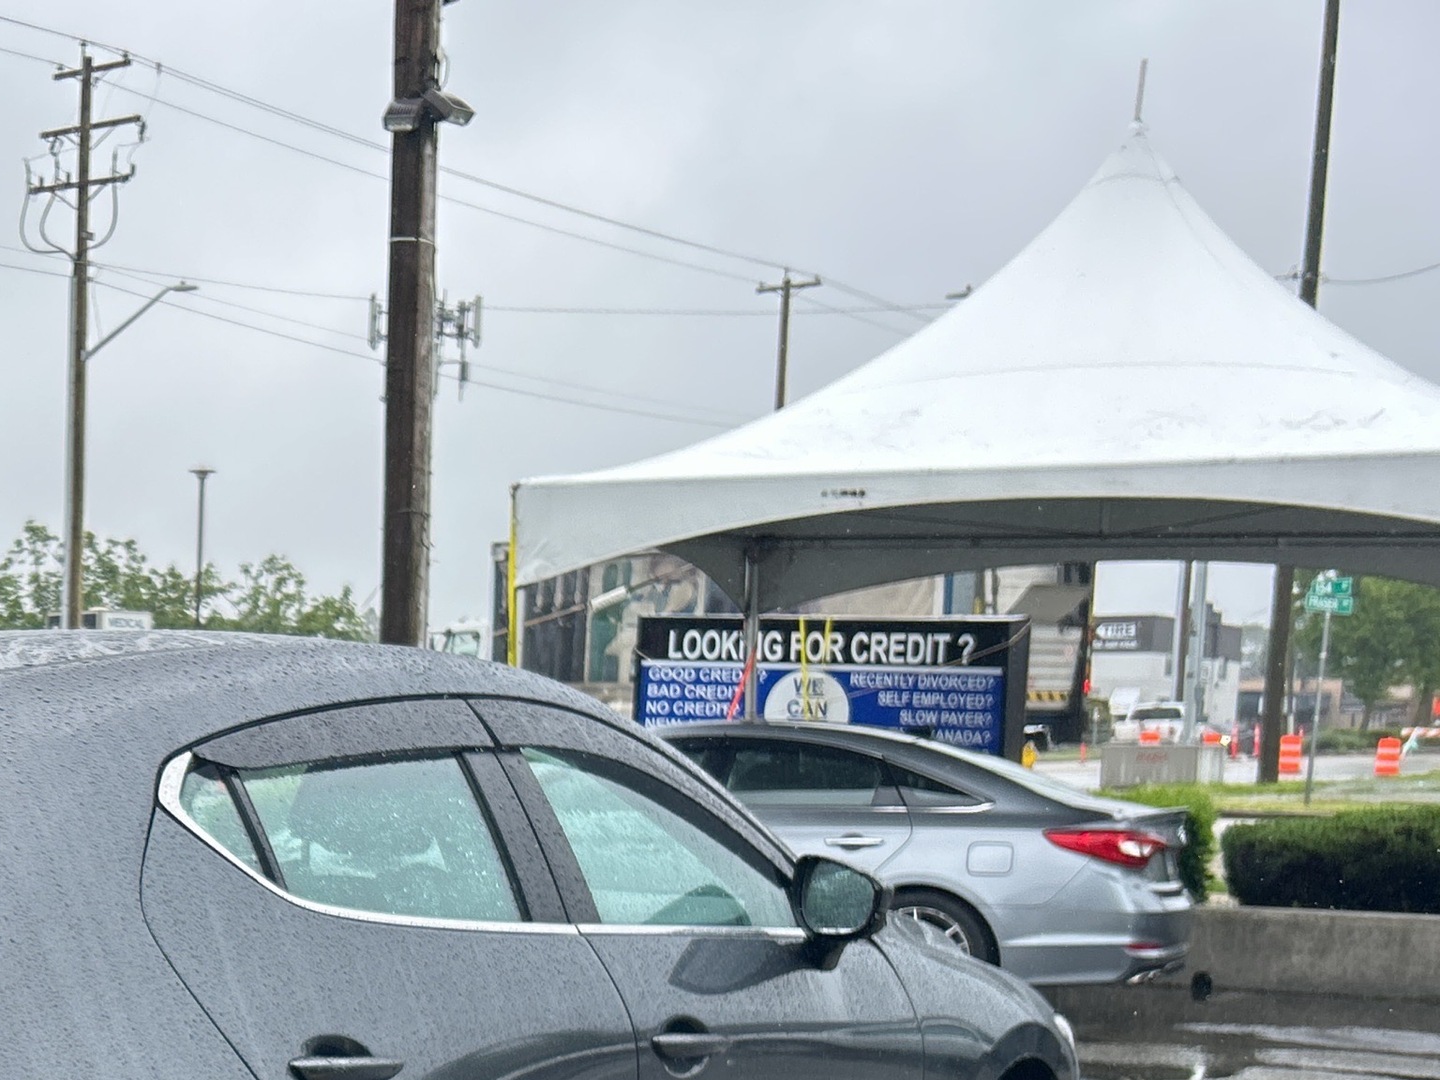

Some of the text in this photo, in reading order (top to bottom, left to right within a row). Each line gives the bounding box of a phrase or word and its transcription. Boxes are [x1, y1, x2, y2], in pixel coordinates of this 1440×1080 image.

[668, 629, 783, 661] LOOKIG
[790, 631, 844, 663] FOR
[850, 632, 952, 665] CREDIT
[648, 665, 767, 685] GOOD CRED?
[850, 673, 995, 690] RECENTLY DIVORCED?
[647, 683, 681, 699] BAD
[793, 677, 824, 695] WE
[646, 700, 670, 715] NO
[877, 691, 994, 709] SELF EMPLOYED?
[787, 699, 828, 720] CAN
[899, 709, 993, 728] SLOW PAYER?
